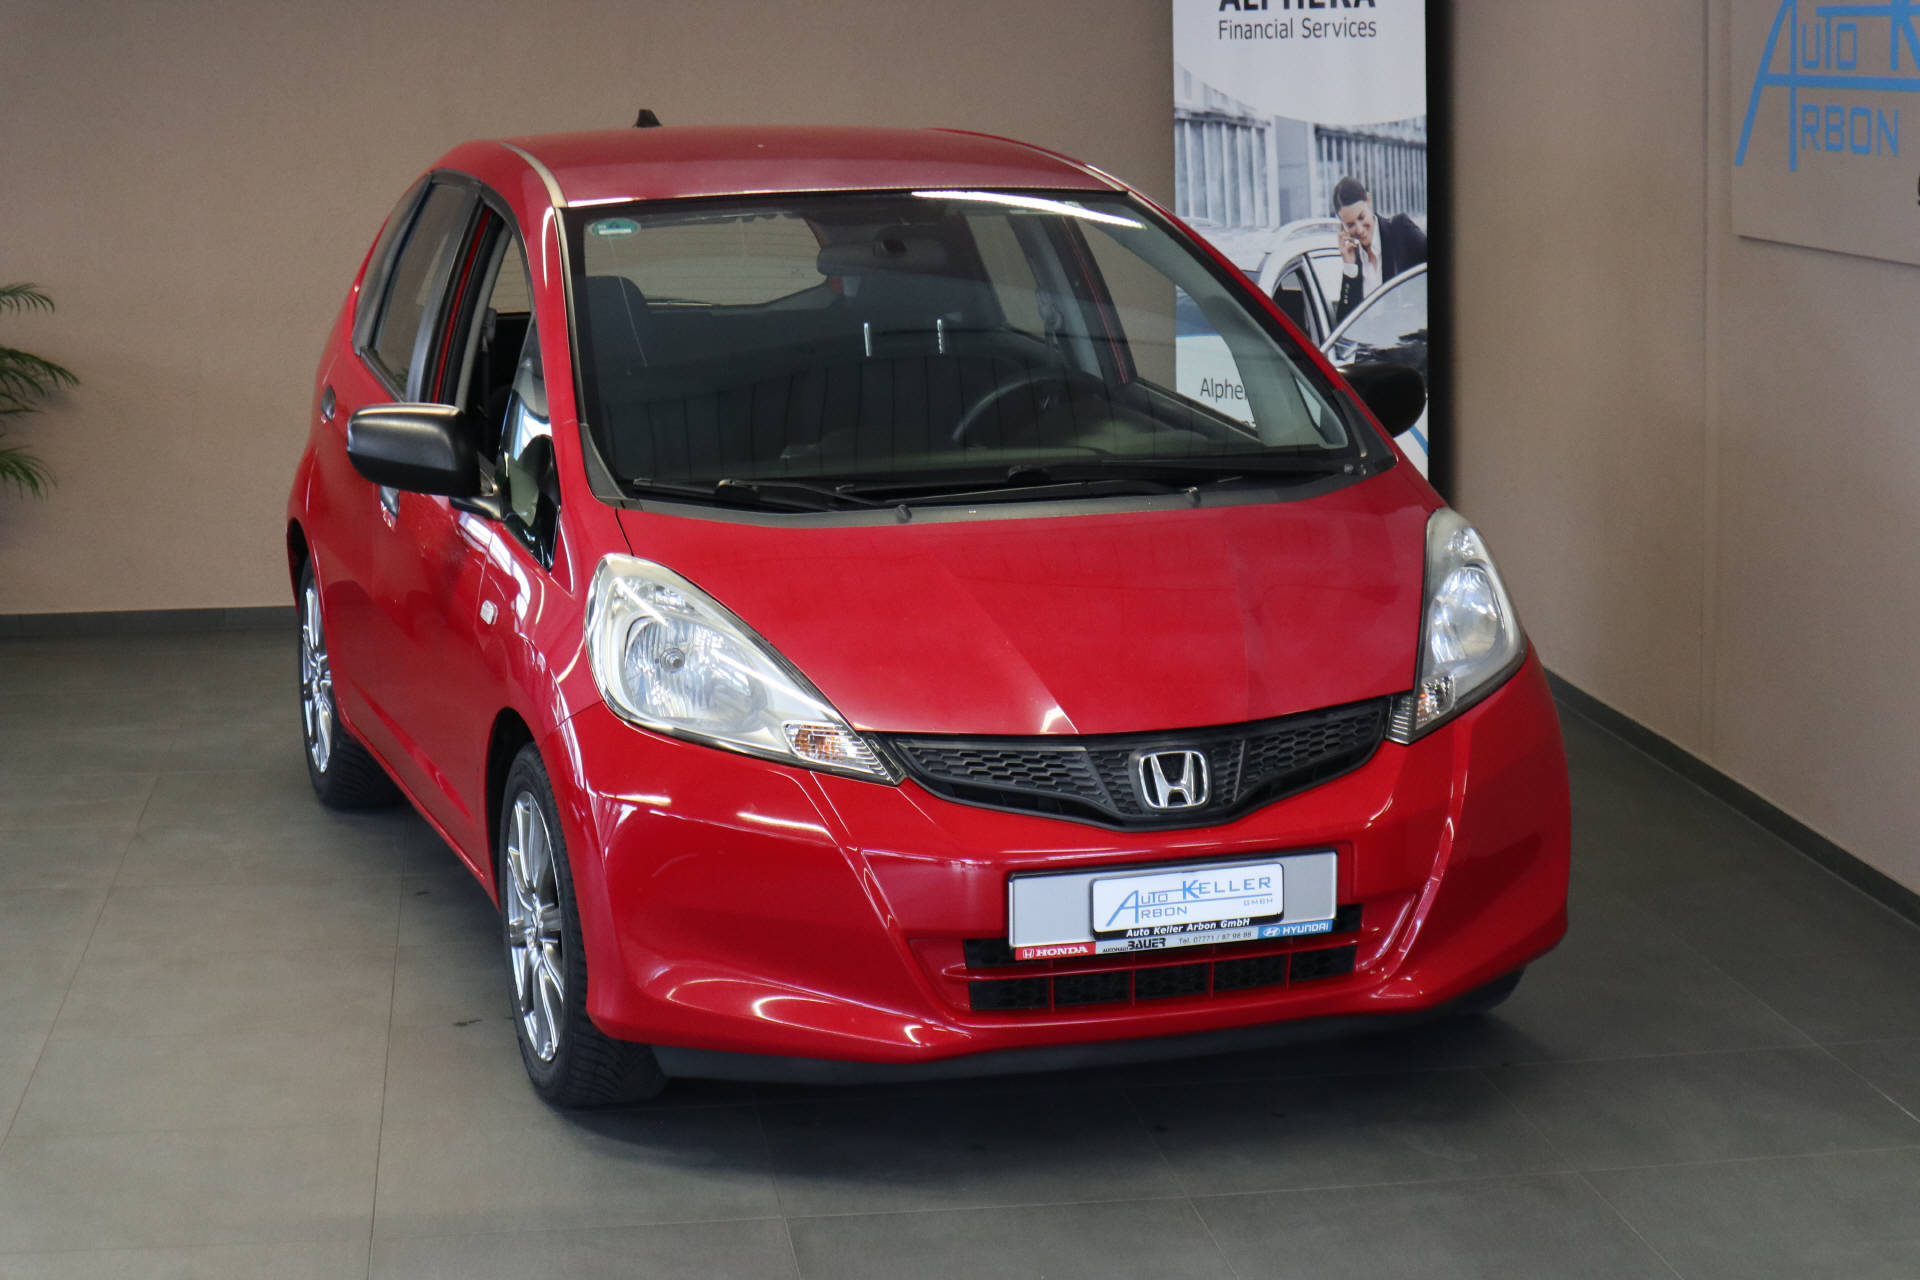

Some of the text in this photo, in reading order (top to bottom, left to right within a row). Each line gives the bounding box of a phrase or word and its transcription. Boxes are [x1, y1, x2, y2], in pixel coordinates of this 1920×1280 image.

[1218, 16, 1377, 40] Financial Services
[1200, 377, 1248, 403] Alphe
[1182, 876, 1272, 900] KELLER
[1126, 918, 1251, 938] Auto Keller Arbon GmbH
[1283, 922, 1329, 935] HYUNDAI
[1035, 945, 1089, 957] HONDA
[1127, 937, 1167, 951] BAUER
